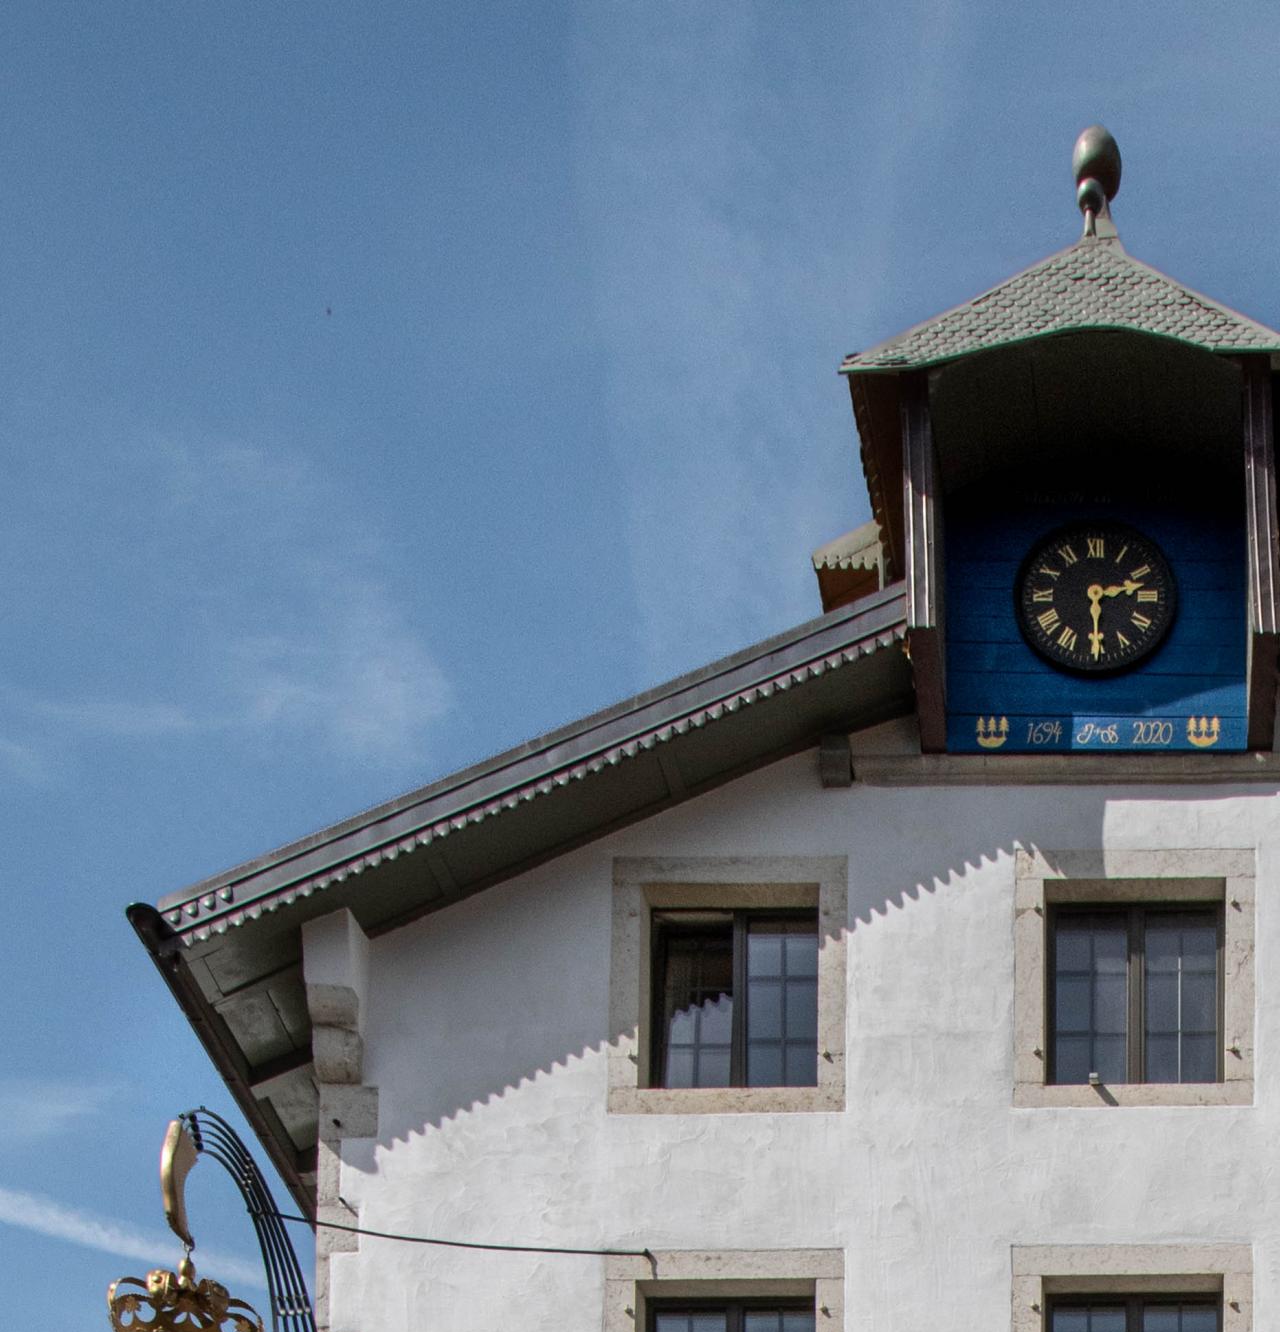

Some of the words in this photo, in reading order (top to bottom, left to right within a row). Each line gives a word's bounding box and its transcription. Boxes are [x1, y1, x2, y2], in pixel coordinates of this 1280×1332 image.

[1058, 544, 1078, 568] XI
[1086, 538, 1105, 558] XII
[1130, 564, 1151, 580] II
[1032, 588, 1054, 602] IX
[1137, 590, 1158, 602] III
[1026, 720, 1063, 744] 1694
[1132, 721, 1174, 744] 2020
